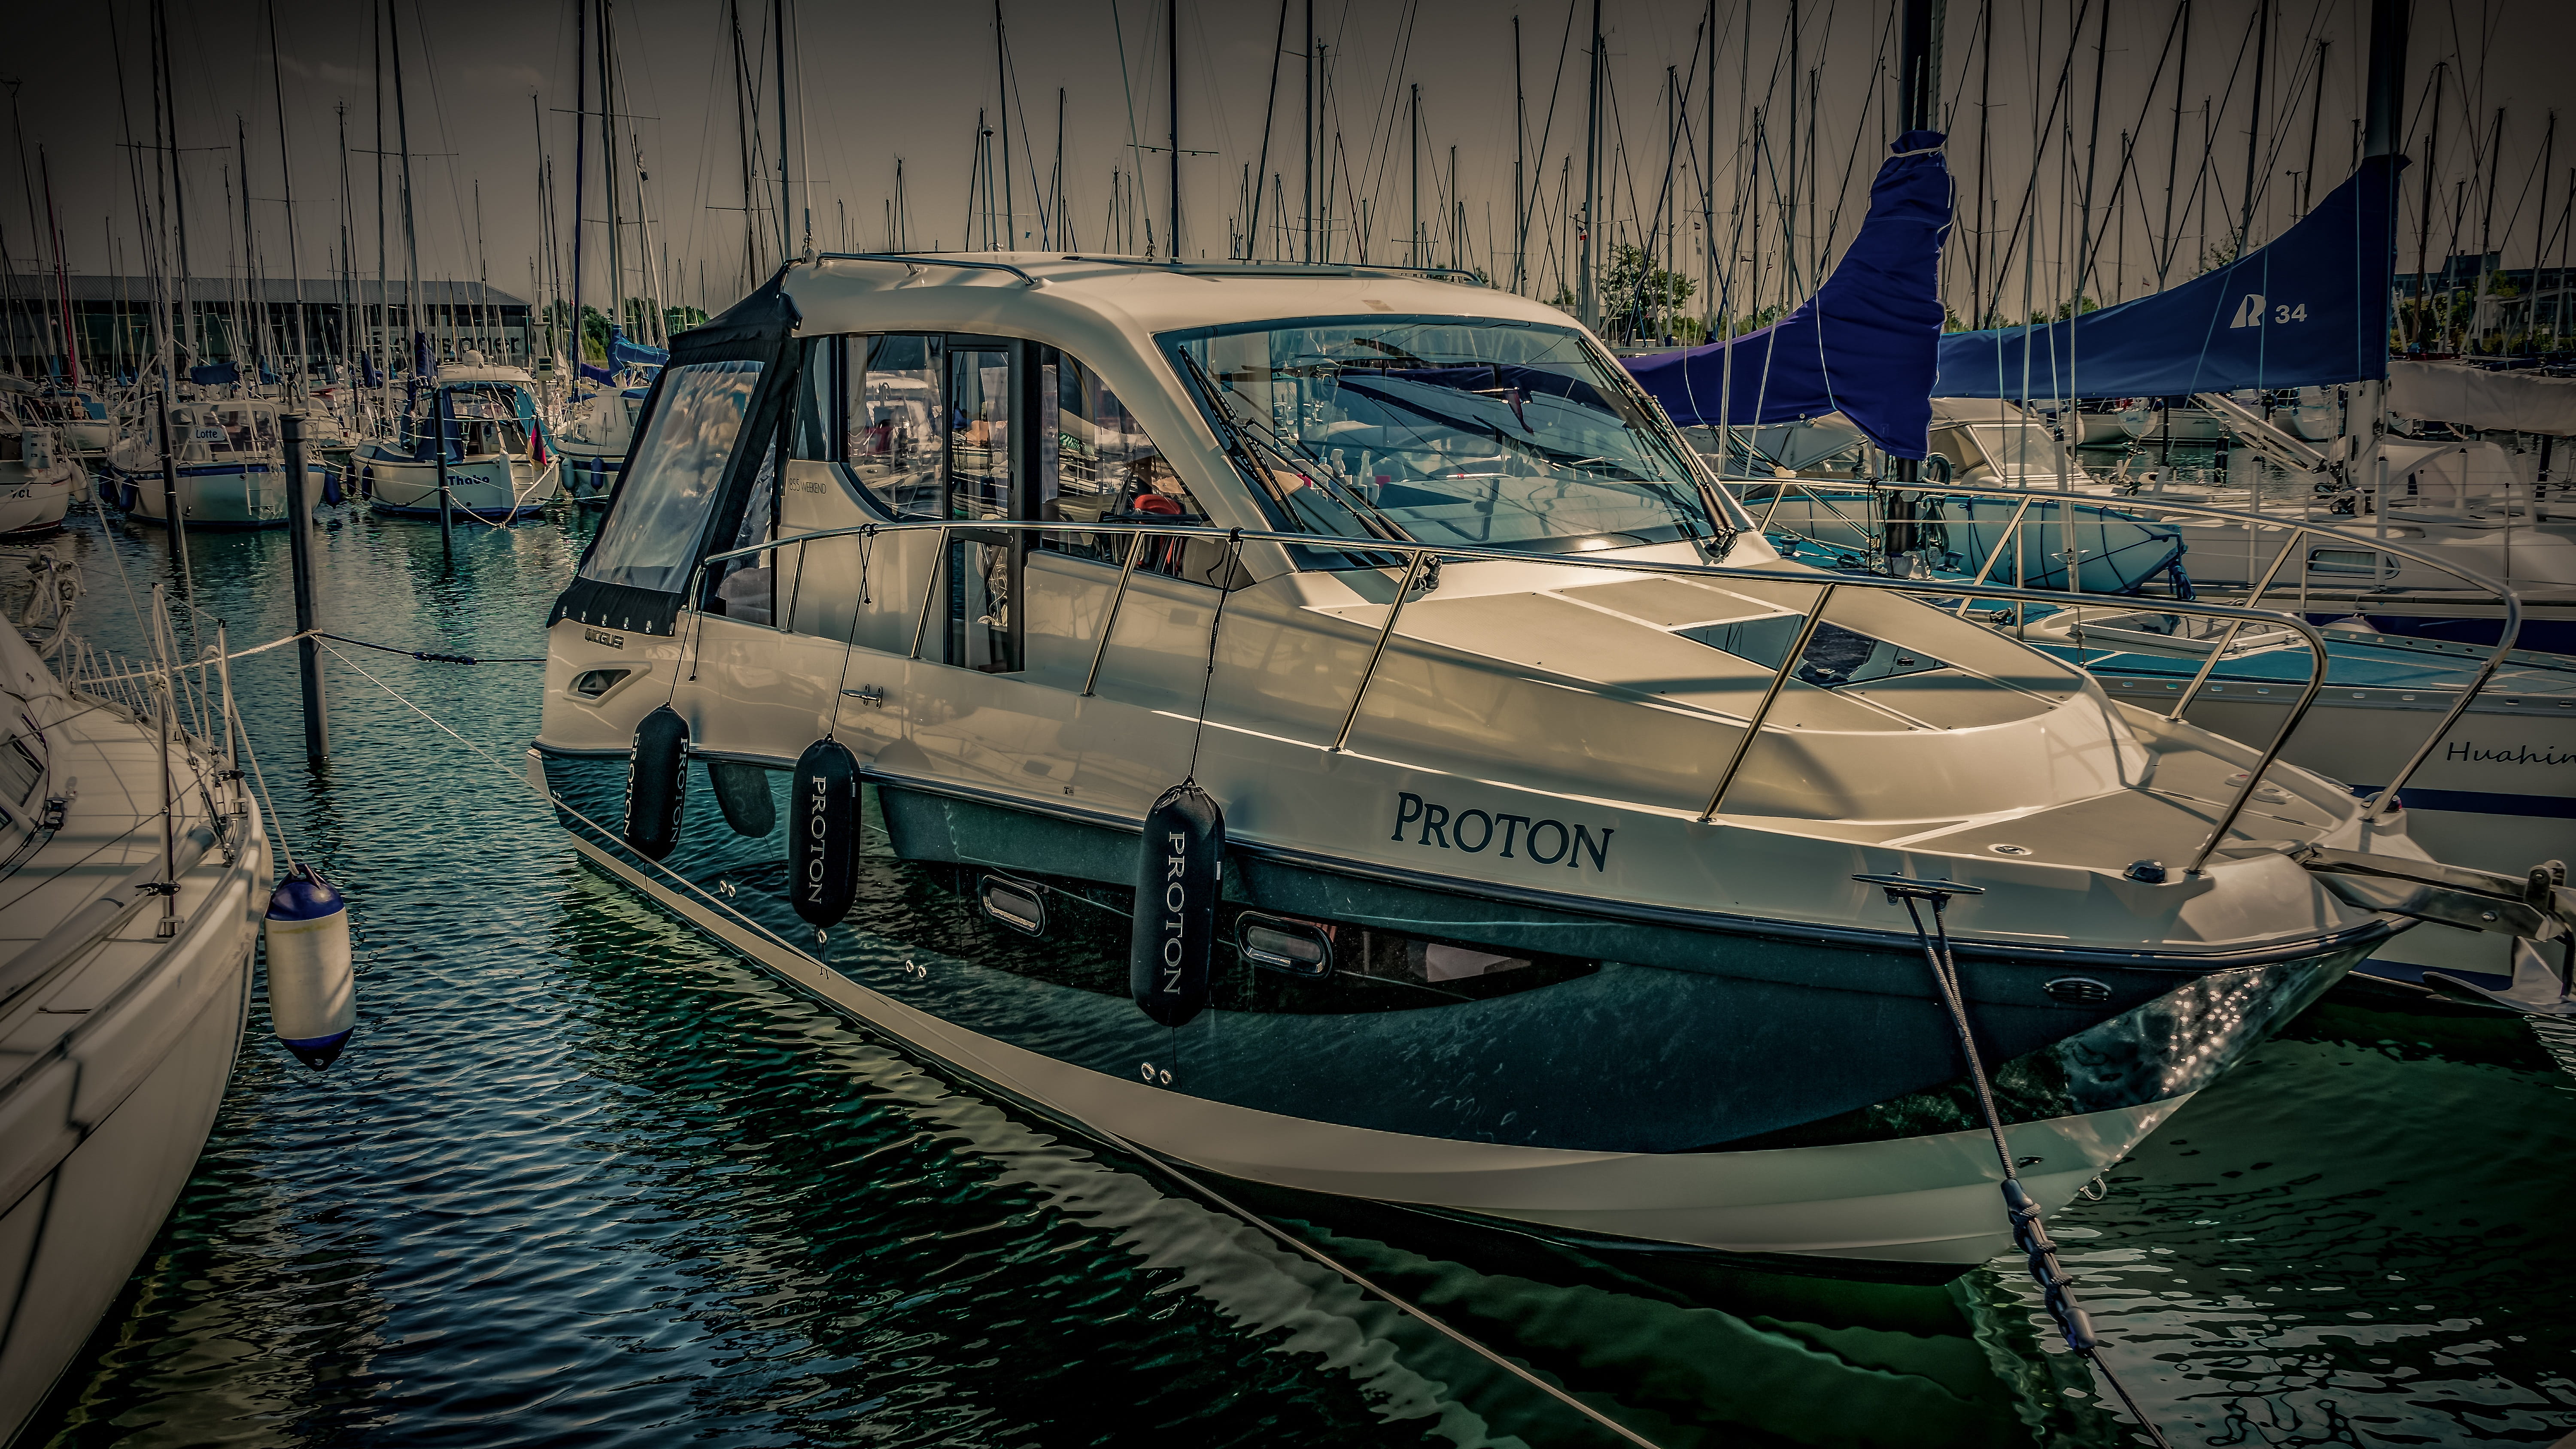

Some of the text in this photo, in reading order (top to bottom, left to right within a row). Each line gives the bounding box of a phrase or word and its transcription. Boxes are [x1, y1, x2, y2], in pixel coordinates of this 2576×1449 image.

[2275, 303, 2307, 324] 34
[196, 429, 218, 439] Lotte
[447, 474, 490, 486] Thabo
[789, 478, 826, 494] 855 WEEKEND
[624, 732, 640, 837] PROTON
[670, 737, 688, 843] PROTON
[808, 775, 826, 904] PROTON
[1391, 791, 1615, 873] PROTON
[1163, 831, 1185, 995] PROTON
